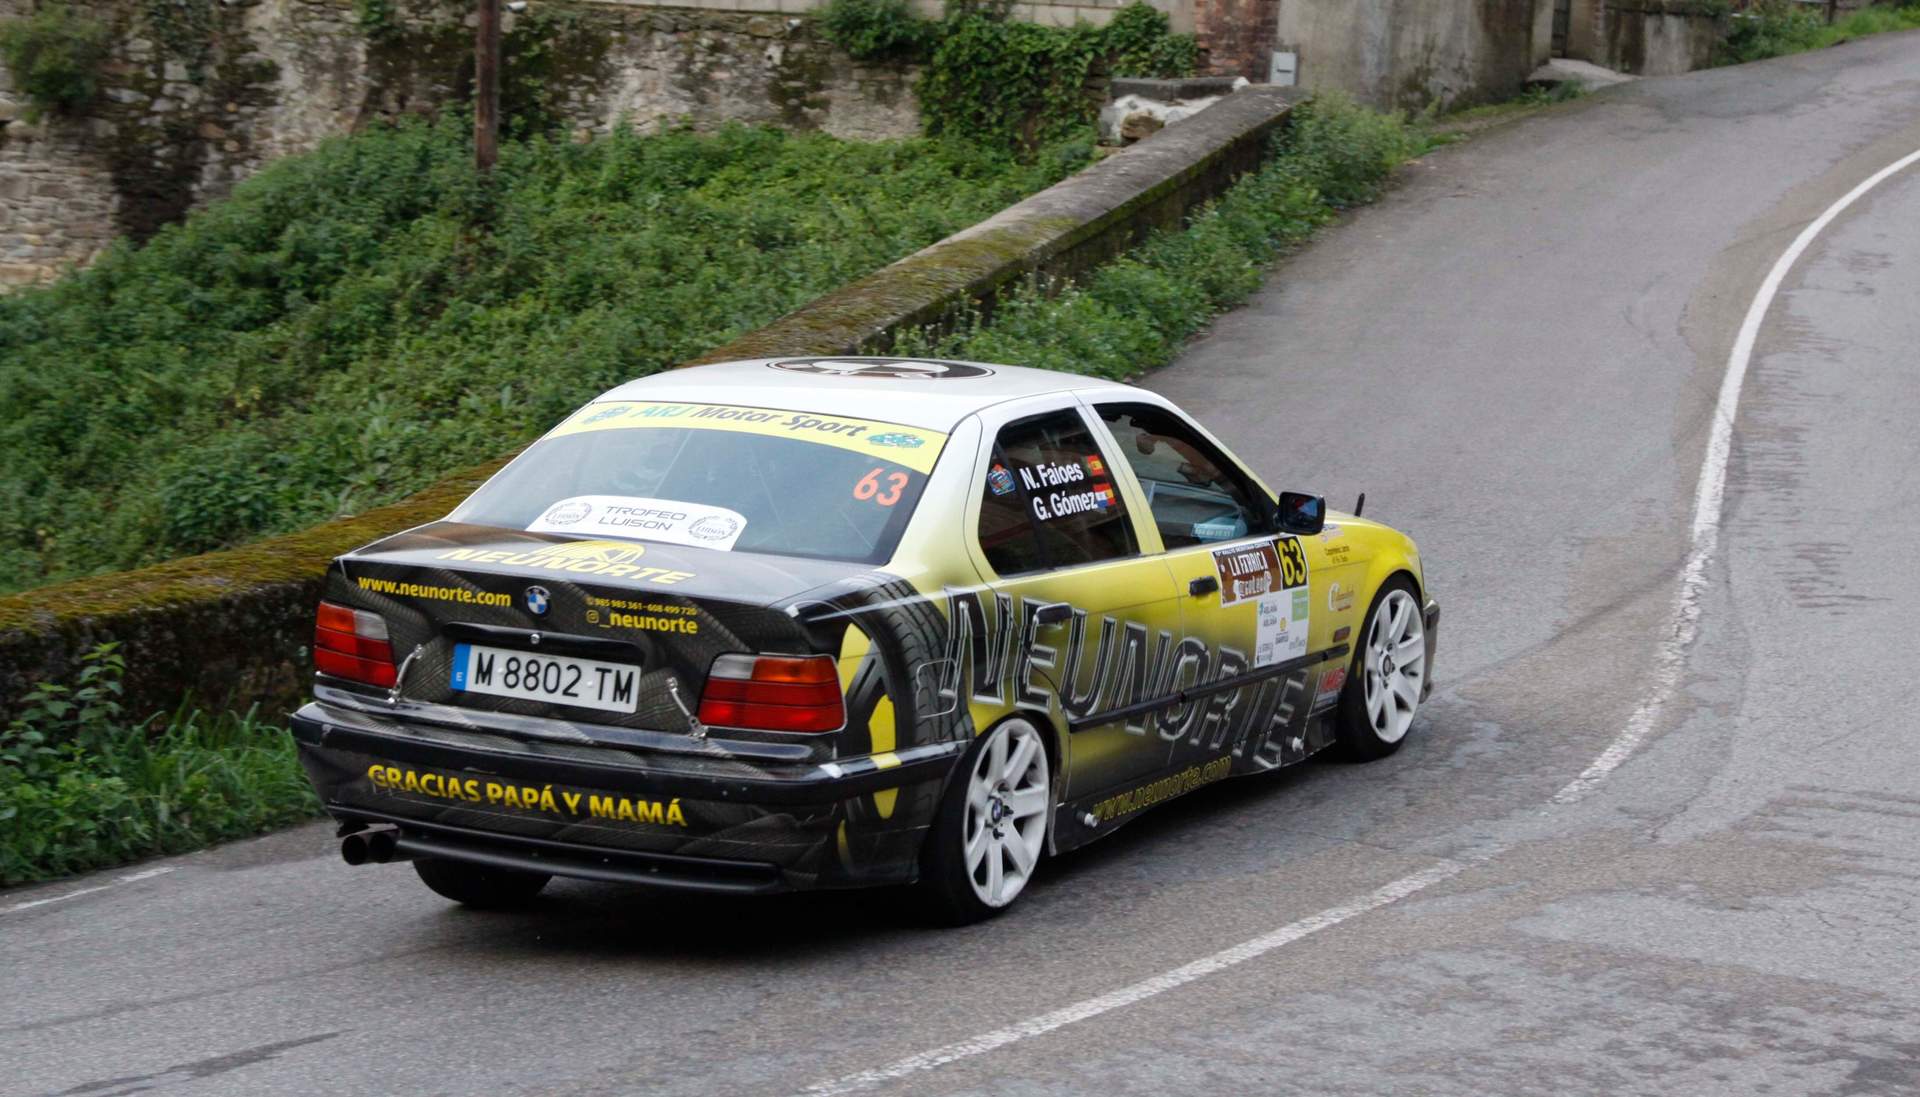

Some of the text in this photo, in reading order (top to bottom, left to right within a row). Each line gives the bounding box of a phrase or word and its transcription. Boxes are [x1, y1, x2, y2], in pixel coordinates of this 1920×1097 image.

[689, 407, 783, 423] Motor
[781, 414, 868, 437] Sport
[852, 467, 909, 506] 63
[1020, 467, 1040, 490] N.
[1037, 462, 1084, 487] Faioes
[606, 505, 688, 521] TROFEO
[1033, 491, 1098, 521] G. Gómez
[598, 517, 673, 531] LUISON
[437, 548, 697, 584] NEUNORTE
[1278, 538, 1306, 587] 63
[357, 576, 511, 608] www.neunorte.com
[474, 651, 636, 705] M 8802 TM
[938, 583, 1311, 769] NEUNORTE
[367, 763, 688, 827] GRACIAS PAPÁ Y MAMÁ
